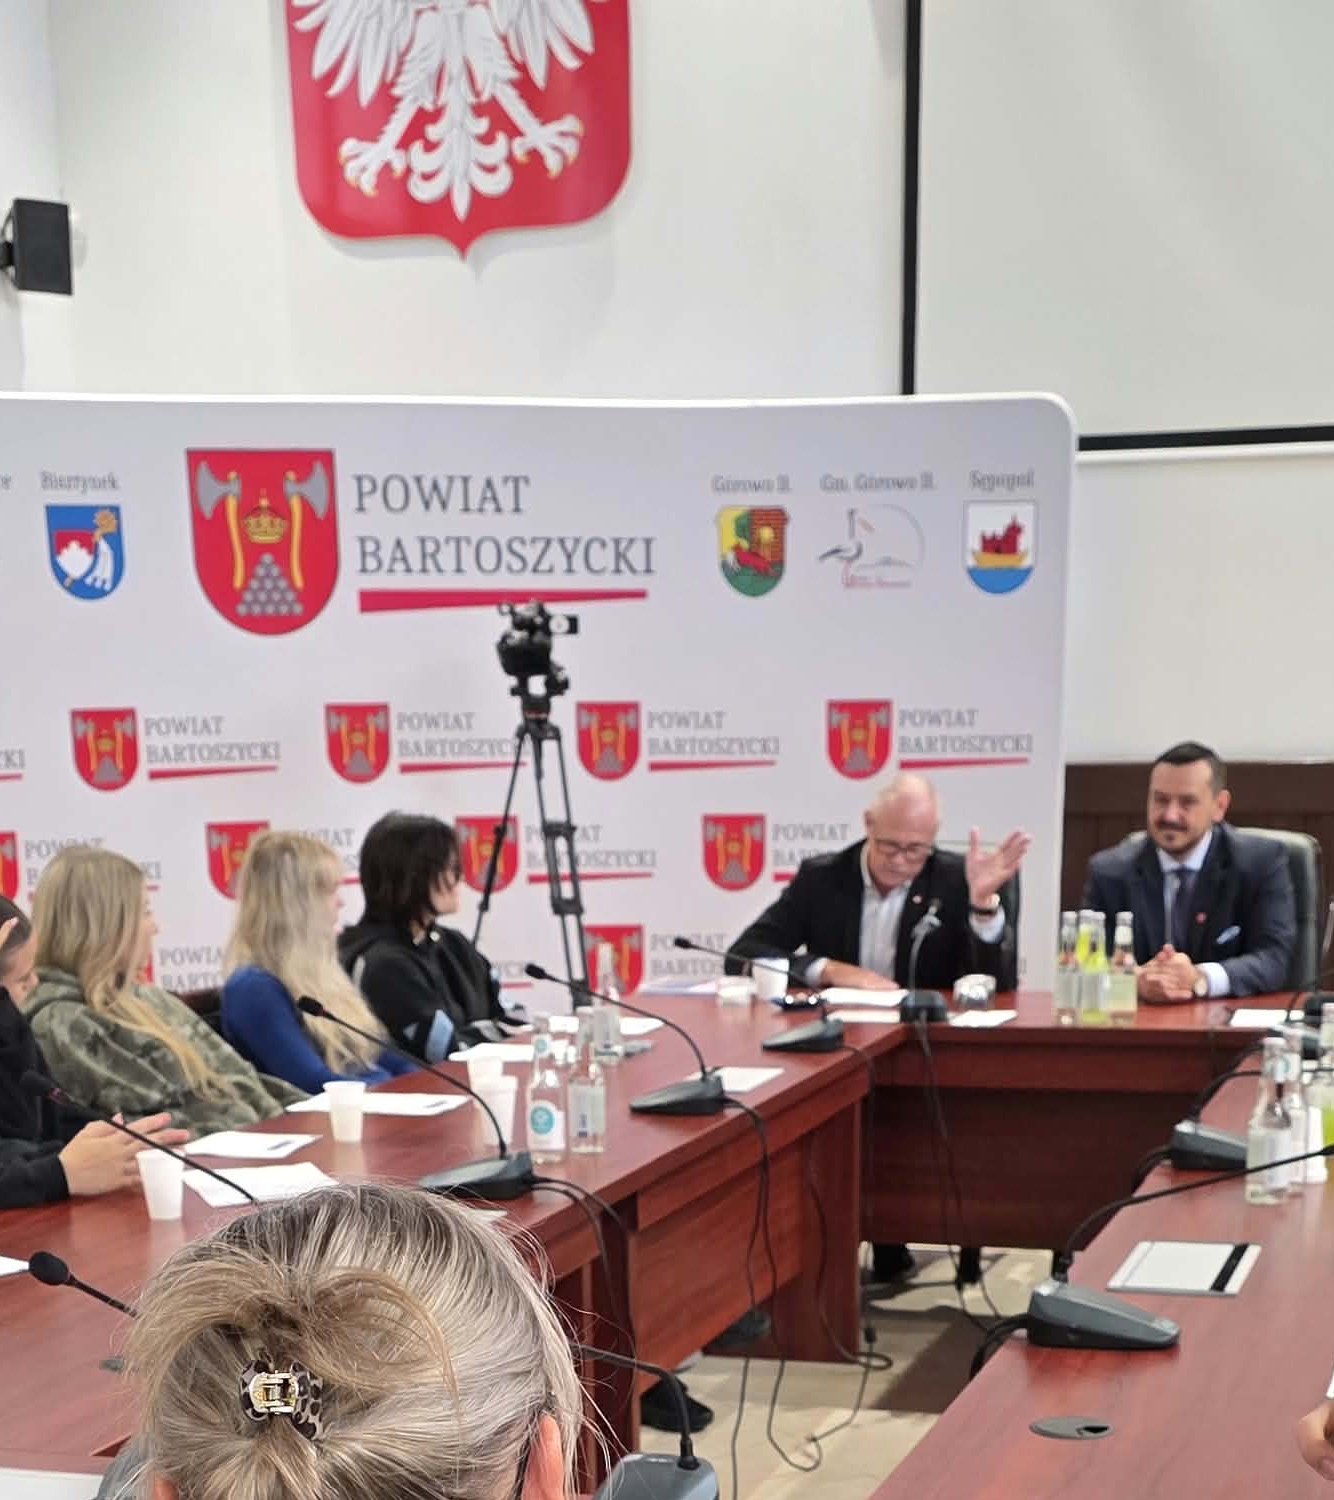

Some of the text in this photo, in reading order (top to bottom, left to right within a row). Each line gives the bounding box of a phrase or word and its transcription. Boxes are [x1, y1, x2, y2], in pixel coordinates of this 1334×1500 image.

[353, 473, 531, 514] POWIAT
[357, 535, 657, 575] BARTOSZYCKI
[145, 717, 224, 736] POWIAT
[397, 712, 475, 730] POWIAT
[647, 711, 726, 730] POWIAT
[899, 709, 978, 728] POWIAT
[147, 742, 281, 763] BARTOSZYCKI
[648, 737, 780, 756] BARTOSZYCKI
[899, 734, 1033, 754] BARTOSZYCKI
[772, 824, 849, 841] POWIAT
[159, 946, 222, 966] POWI
